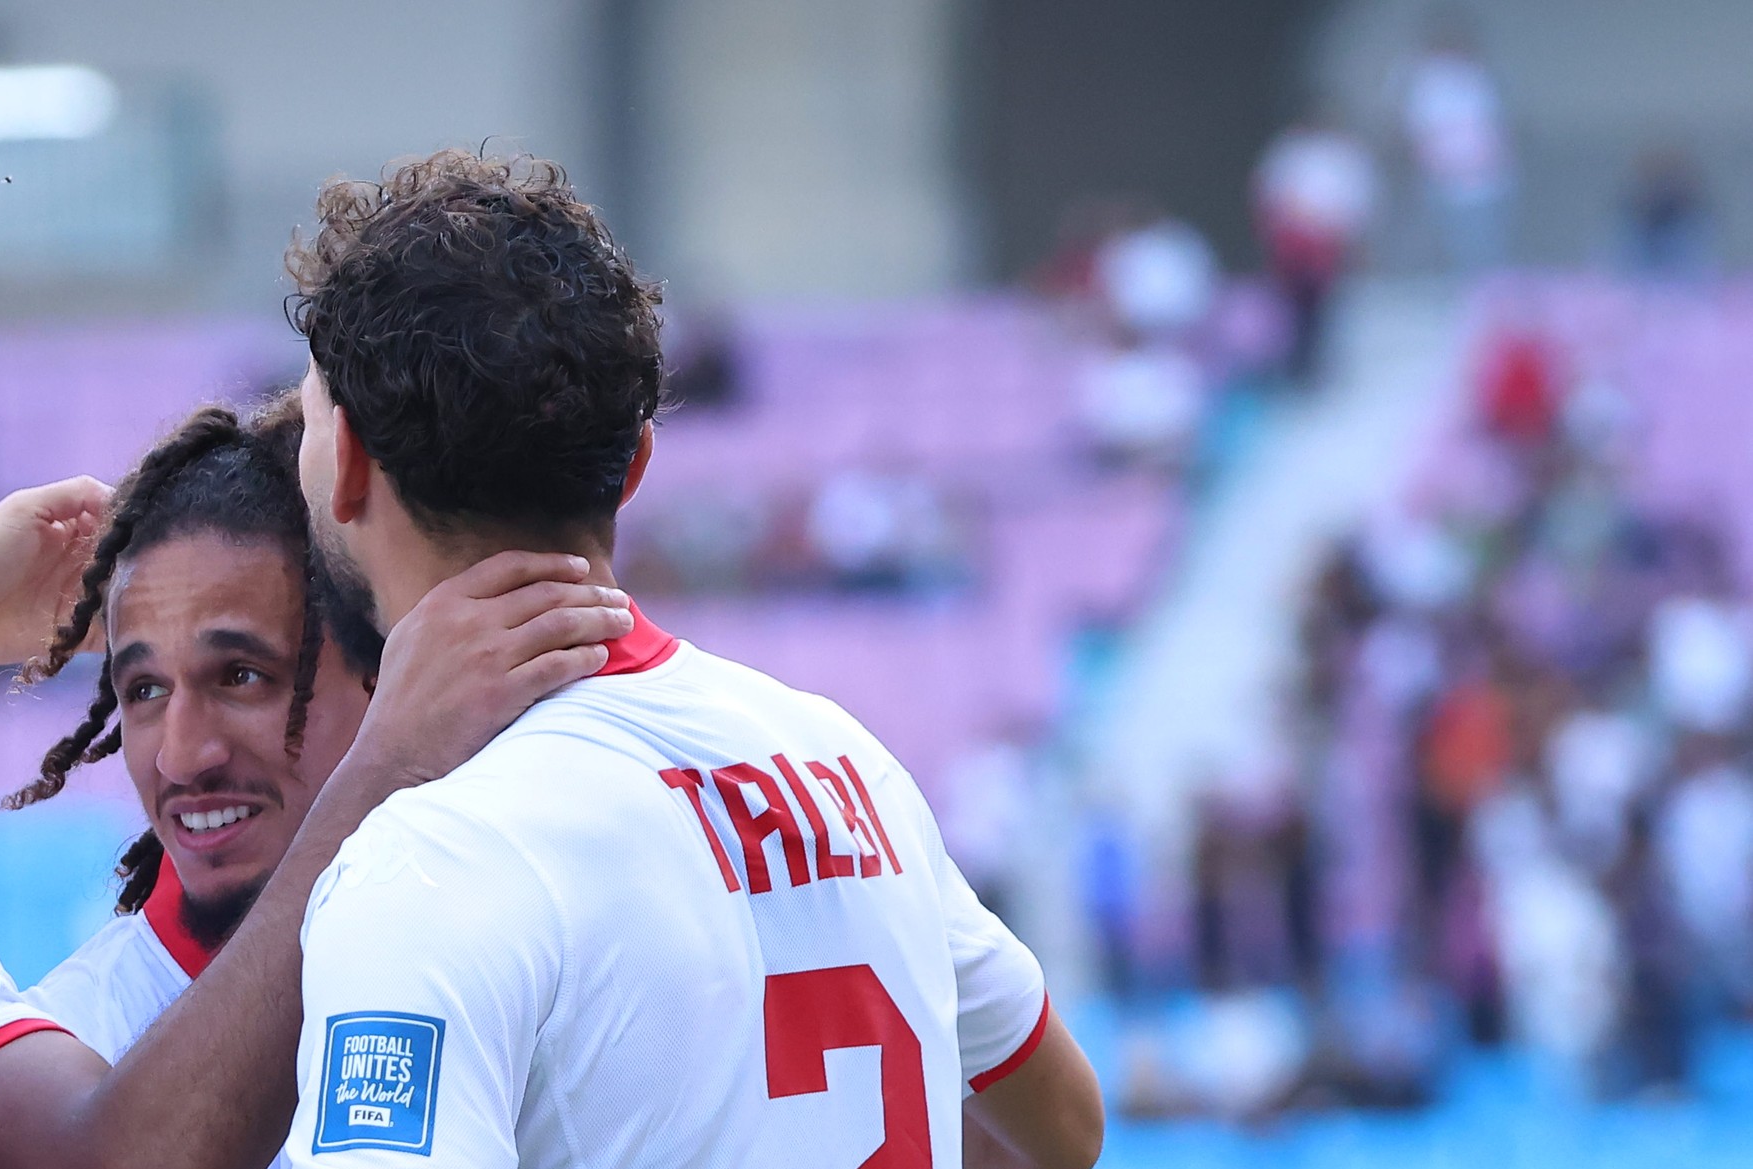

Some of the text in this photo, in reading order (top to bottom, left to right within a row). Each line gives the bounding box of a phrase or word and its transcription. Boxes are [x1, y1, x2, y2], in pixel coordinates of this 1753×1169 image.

[658, 754, 903, 893] TALBI
[343, 1035, 414, 1057] FOOTBALL
[341, 1053, 413, 1083] UNITES
[335, 1080, 415, 1108] the World
[353, 1110, 384, 1122] FIFA
